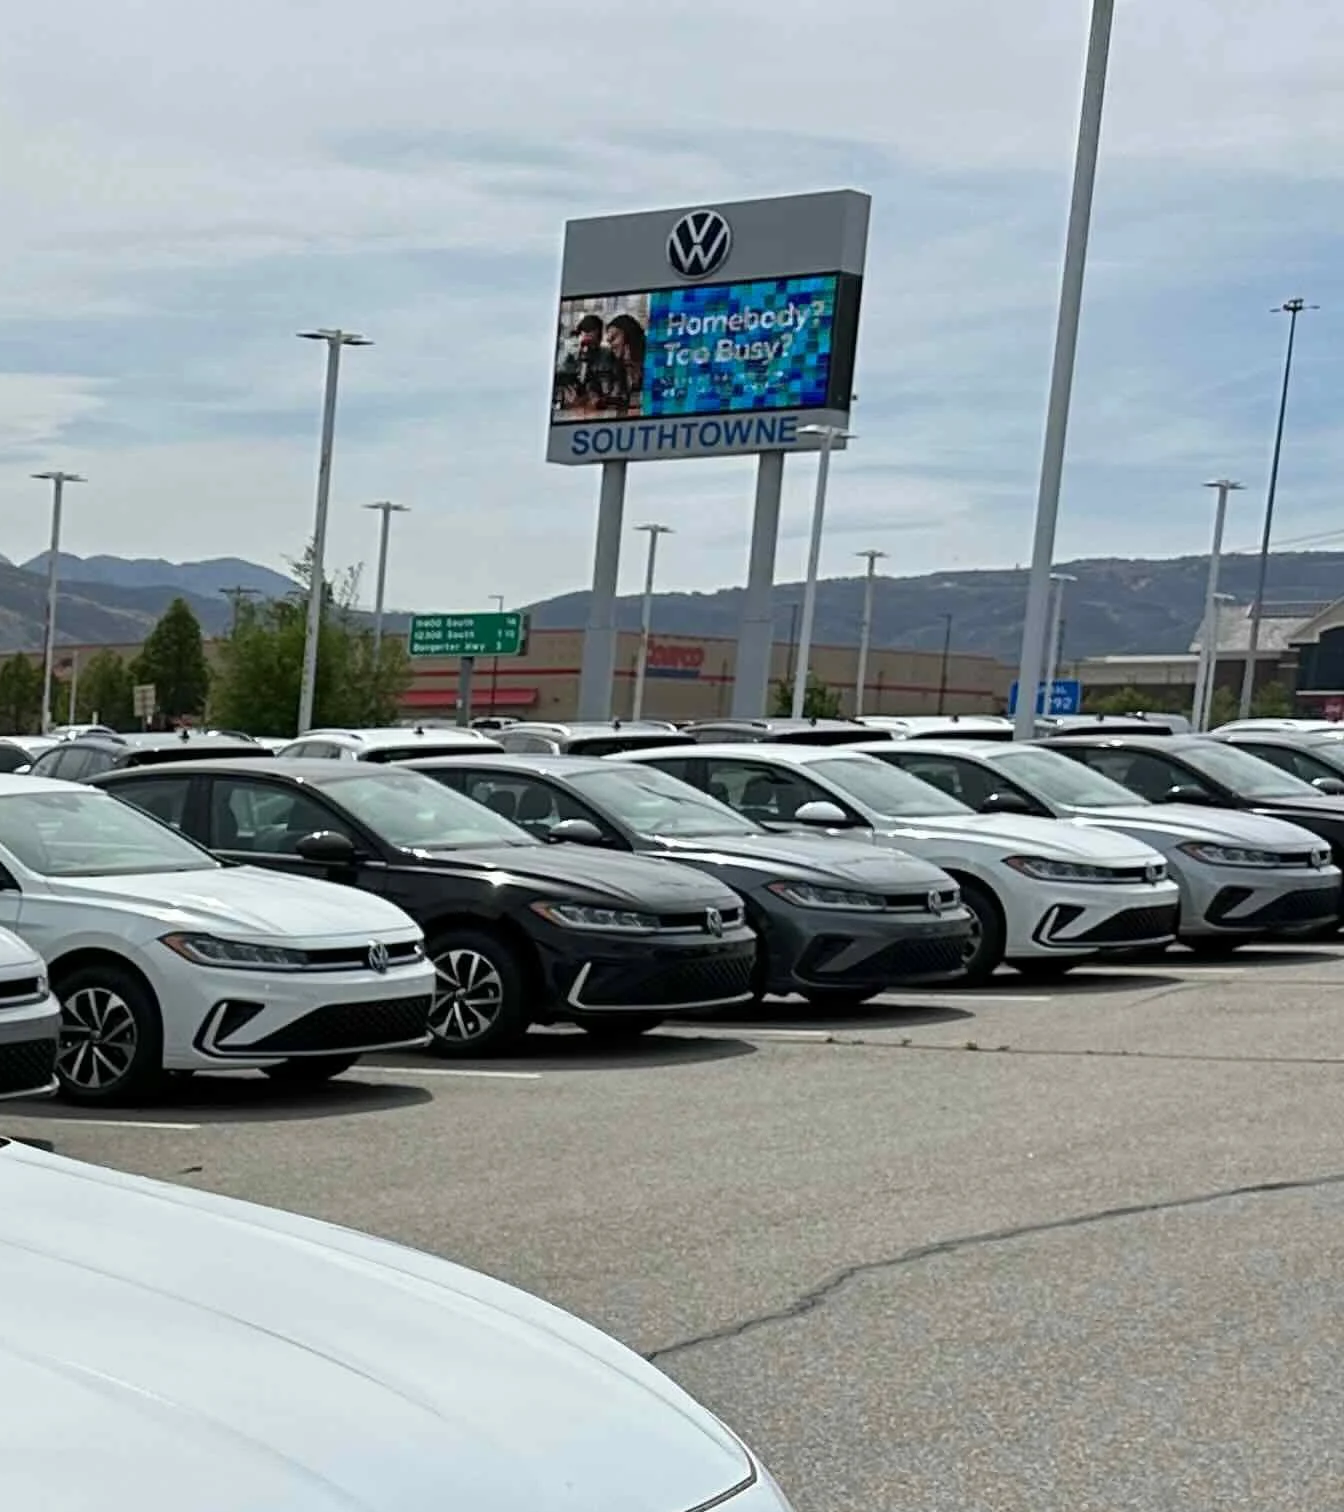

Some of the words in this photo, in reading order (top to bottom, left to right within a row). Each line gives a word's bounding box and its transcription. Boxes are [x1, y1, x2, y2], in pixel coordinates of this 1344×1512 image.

[667, 301, 824, 336] Homebody?
[715, 333, 793, 366] Busy?
[571, 416, 798, 455] SOUTHTOWNE
[446, 617, 474, 628] South
[447, 629, 475, 640] South
